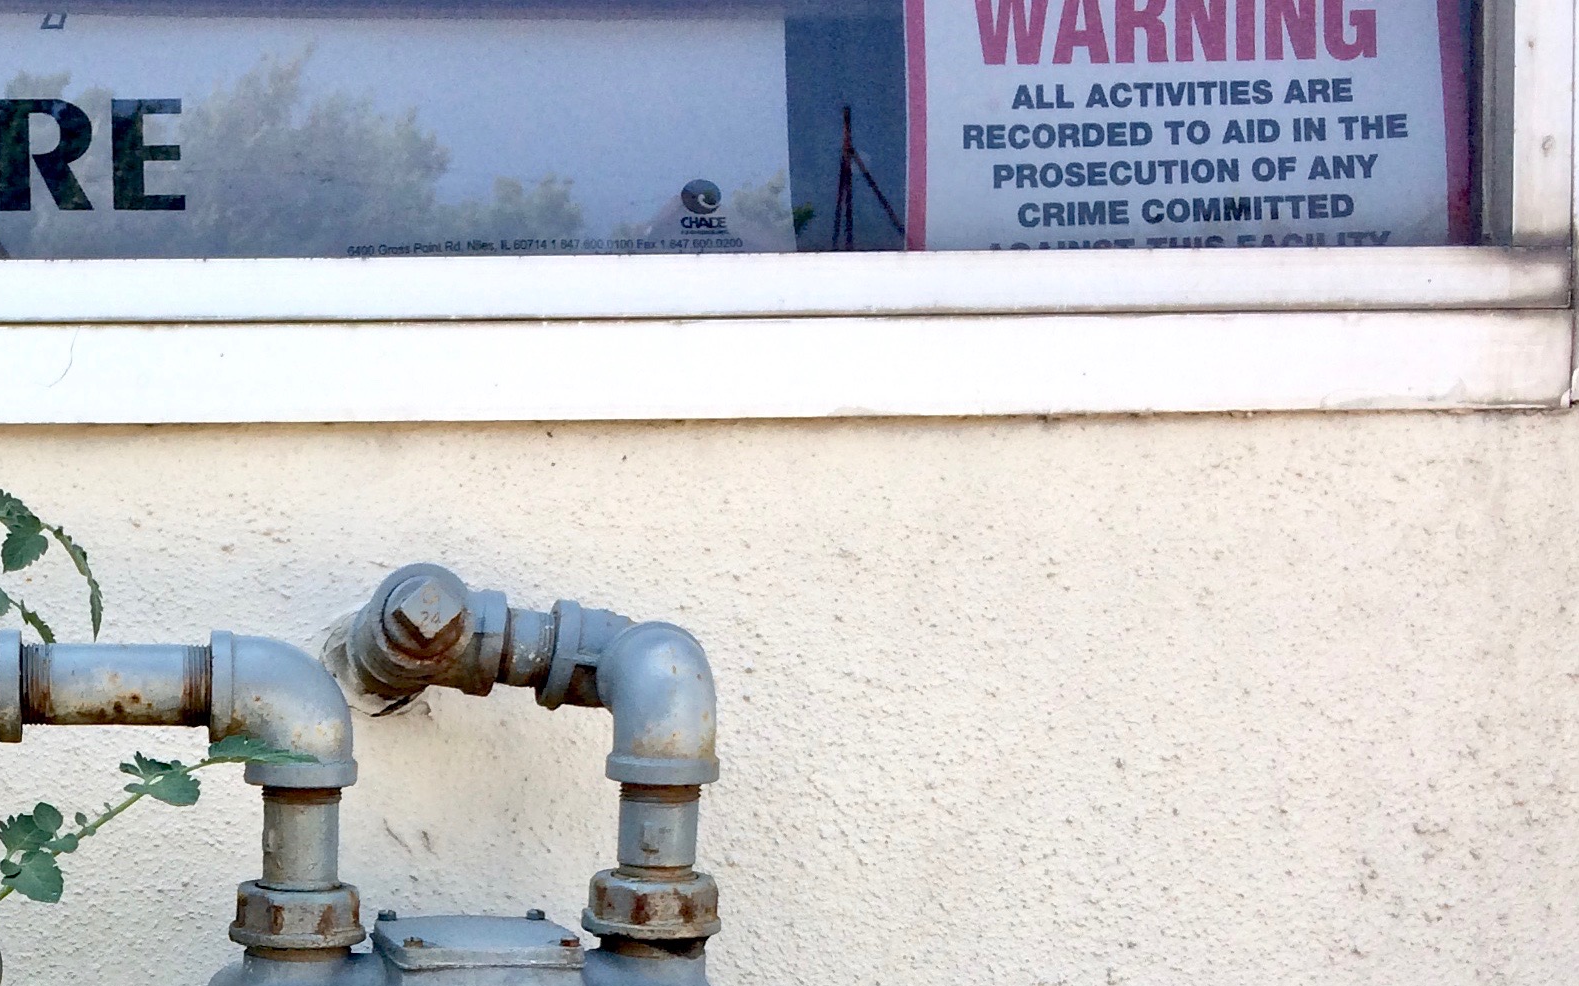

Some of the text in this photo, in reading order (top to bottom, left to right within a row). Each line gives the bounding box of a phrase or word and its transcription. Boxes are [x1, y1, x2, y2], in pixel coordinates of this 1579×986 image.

[975, 0, 1377, 65] WARNING
[1012, 77, 1353, 109] ALL ACTIVITIES ARE
[963, 113, 1408, 149] RECORDED TO AID IN THE
[993, 154, 1378, 189] PROSECUTION OF ANY
[1017, 193, 1354, 227] CRIME COMMITTED
